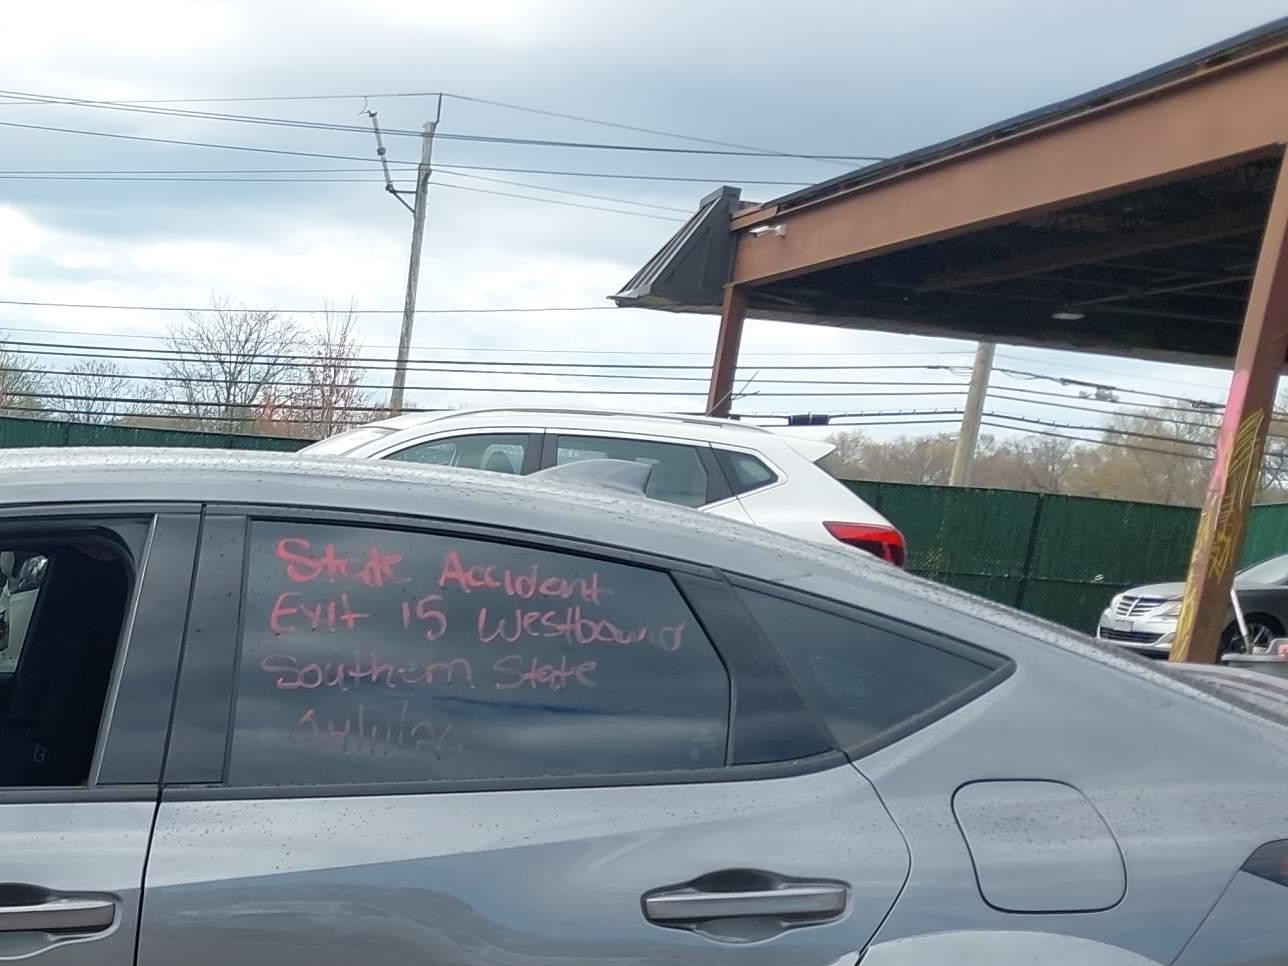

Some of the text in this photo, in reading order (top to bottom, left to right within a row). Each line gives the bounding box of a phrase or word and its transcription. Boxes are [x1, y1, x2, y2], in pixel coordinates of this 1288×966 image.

[275, 538, 612, 605] State Accident
[402, 594, 447, 640] 15
[492, 655, 597, 690] State
